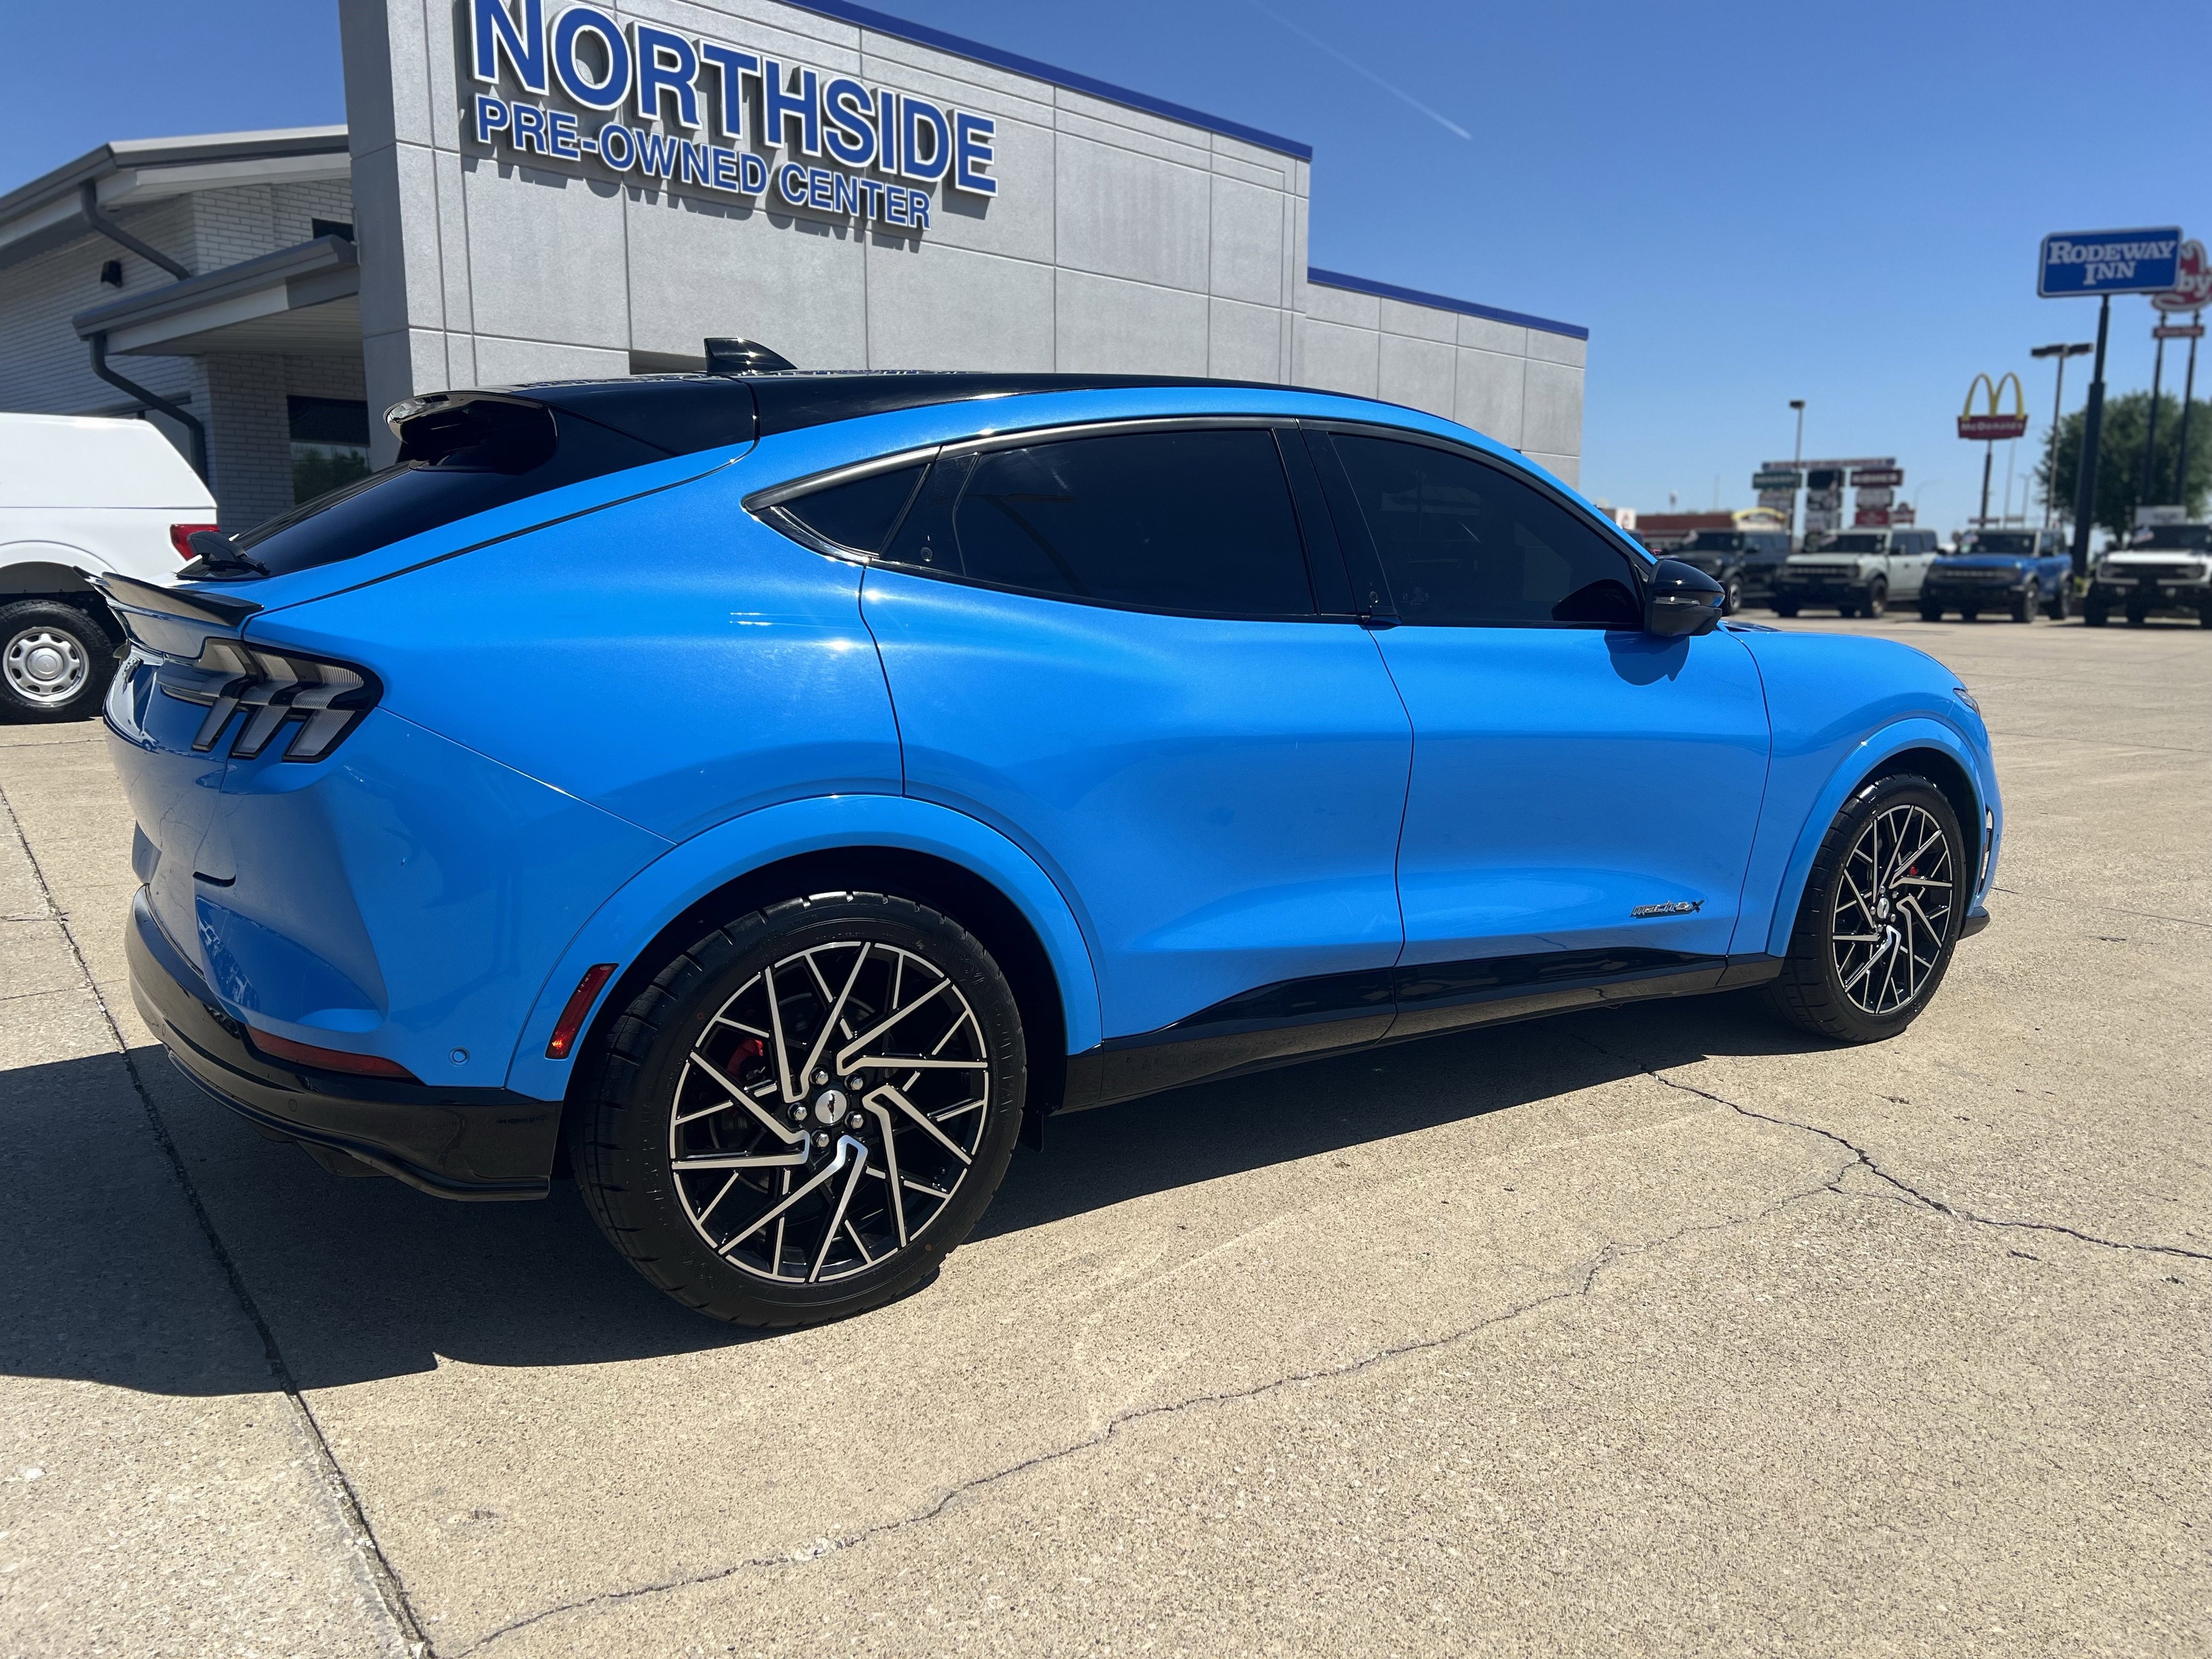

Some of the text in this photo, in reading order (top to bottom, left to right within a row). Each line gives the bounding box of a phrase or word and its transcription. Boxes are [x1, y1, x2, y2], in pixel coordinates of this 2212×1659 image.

[470, 0, 998, 198] NORTHSIDE
[474, 93, 932, 231] PRE-OWNED CENTER
[2083, 261, 2137, 285] INN
